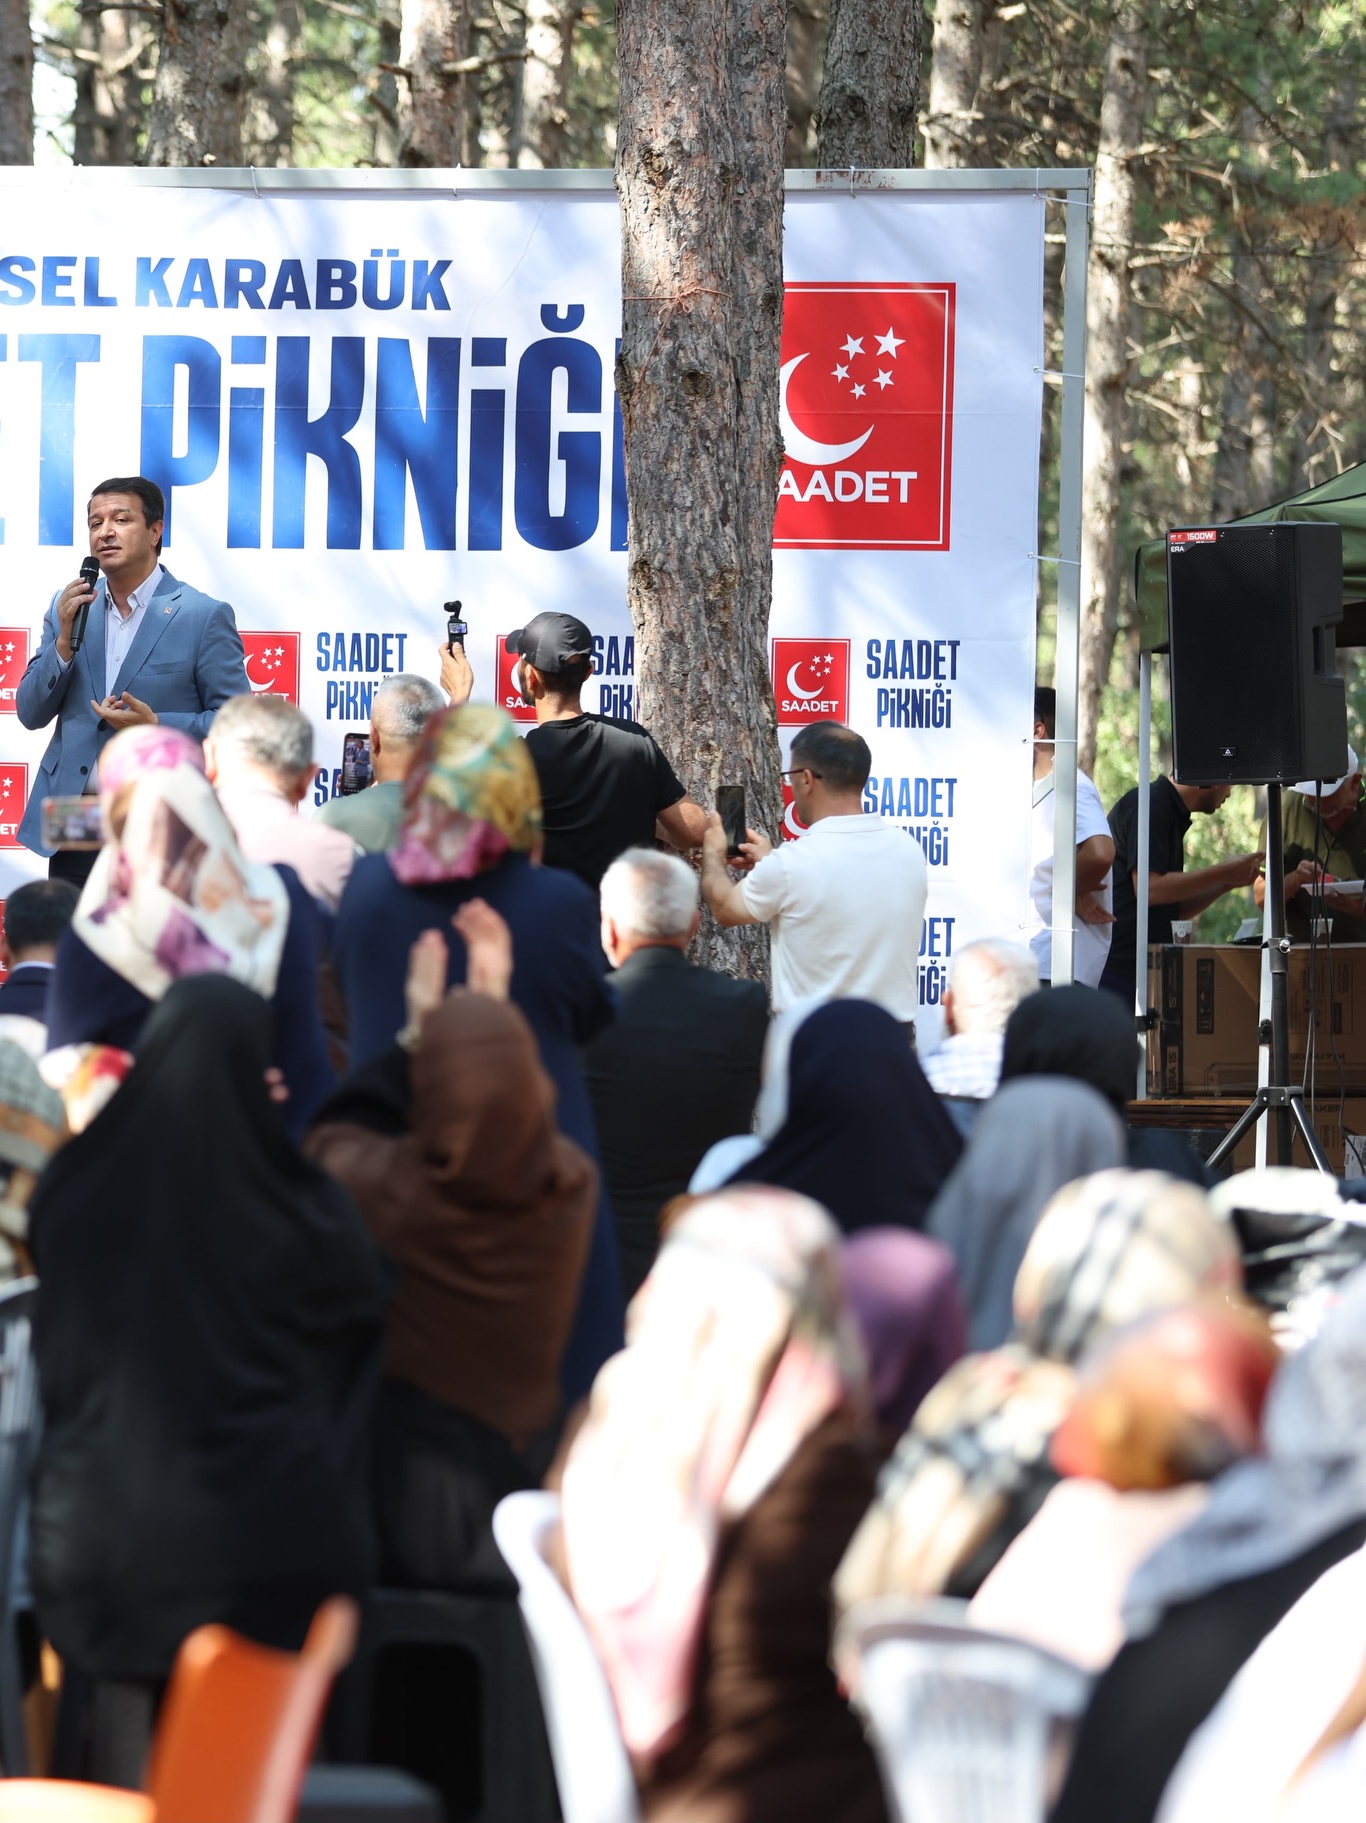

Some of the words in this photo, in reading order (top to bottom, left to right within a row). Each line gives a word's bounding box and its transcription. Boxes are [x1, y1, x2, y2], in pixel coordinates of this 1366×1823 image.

[135, 248, 452, 311] KARABÜK
[777, 469, 918, 503] AADET
[1186, 532, 1214, 540] 1500W
[316, 632, 407, 673] SAADET
[591, 635, 635, 675] SAA
[866, 639, 961, 681] SAADET
[781, 700, 839, 713] SAADET
[864, 777, 958, 818] SAADET
